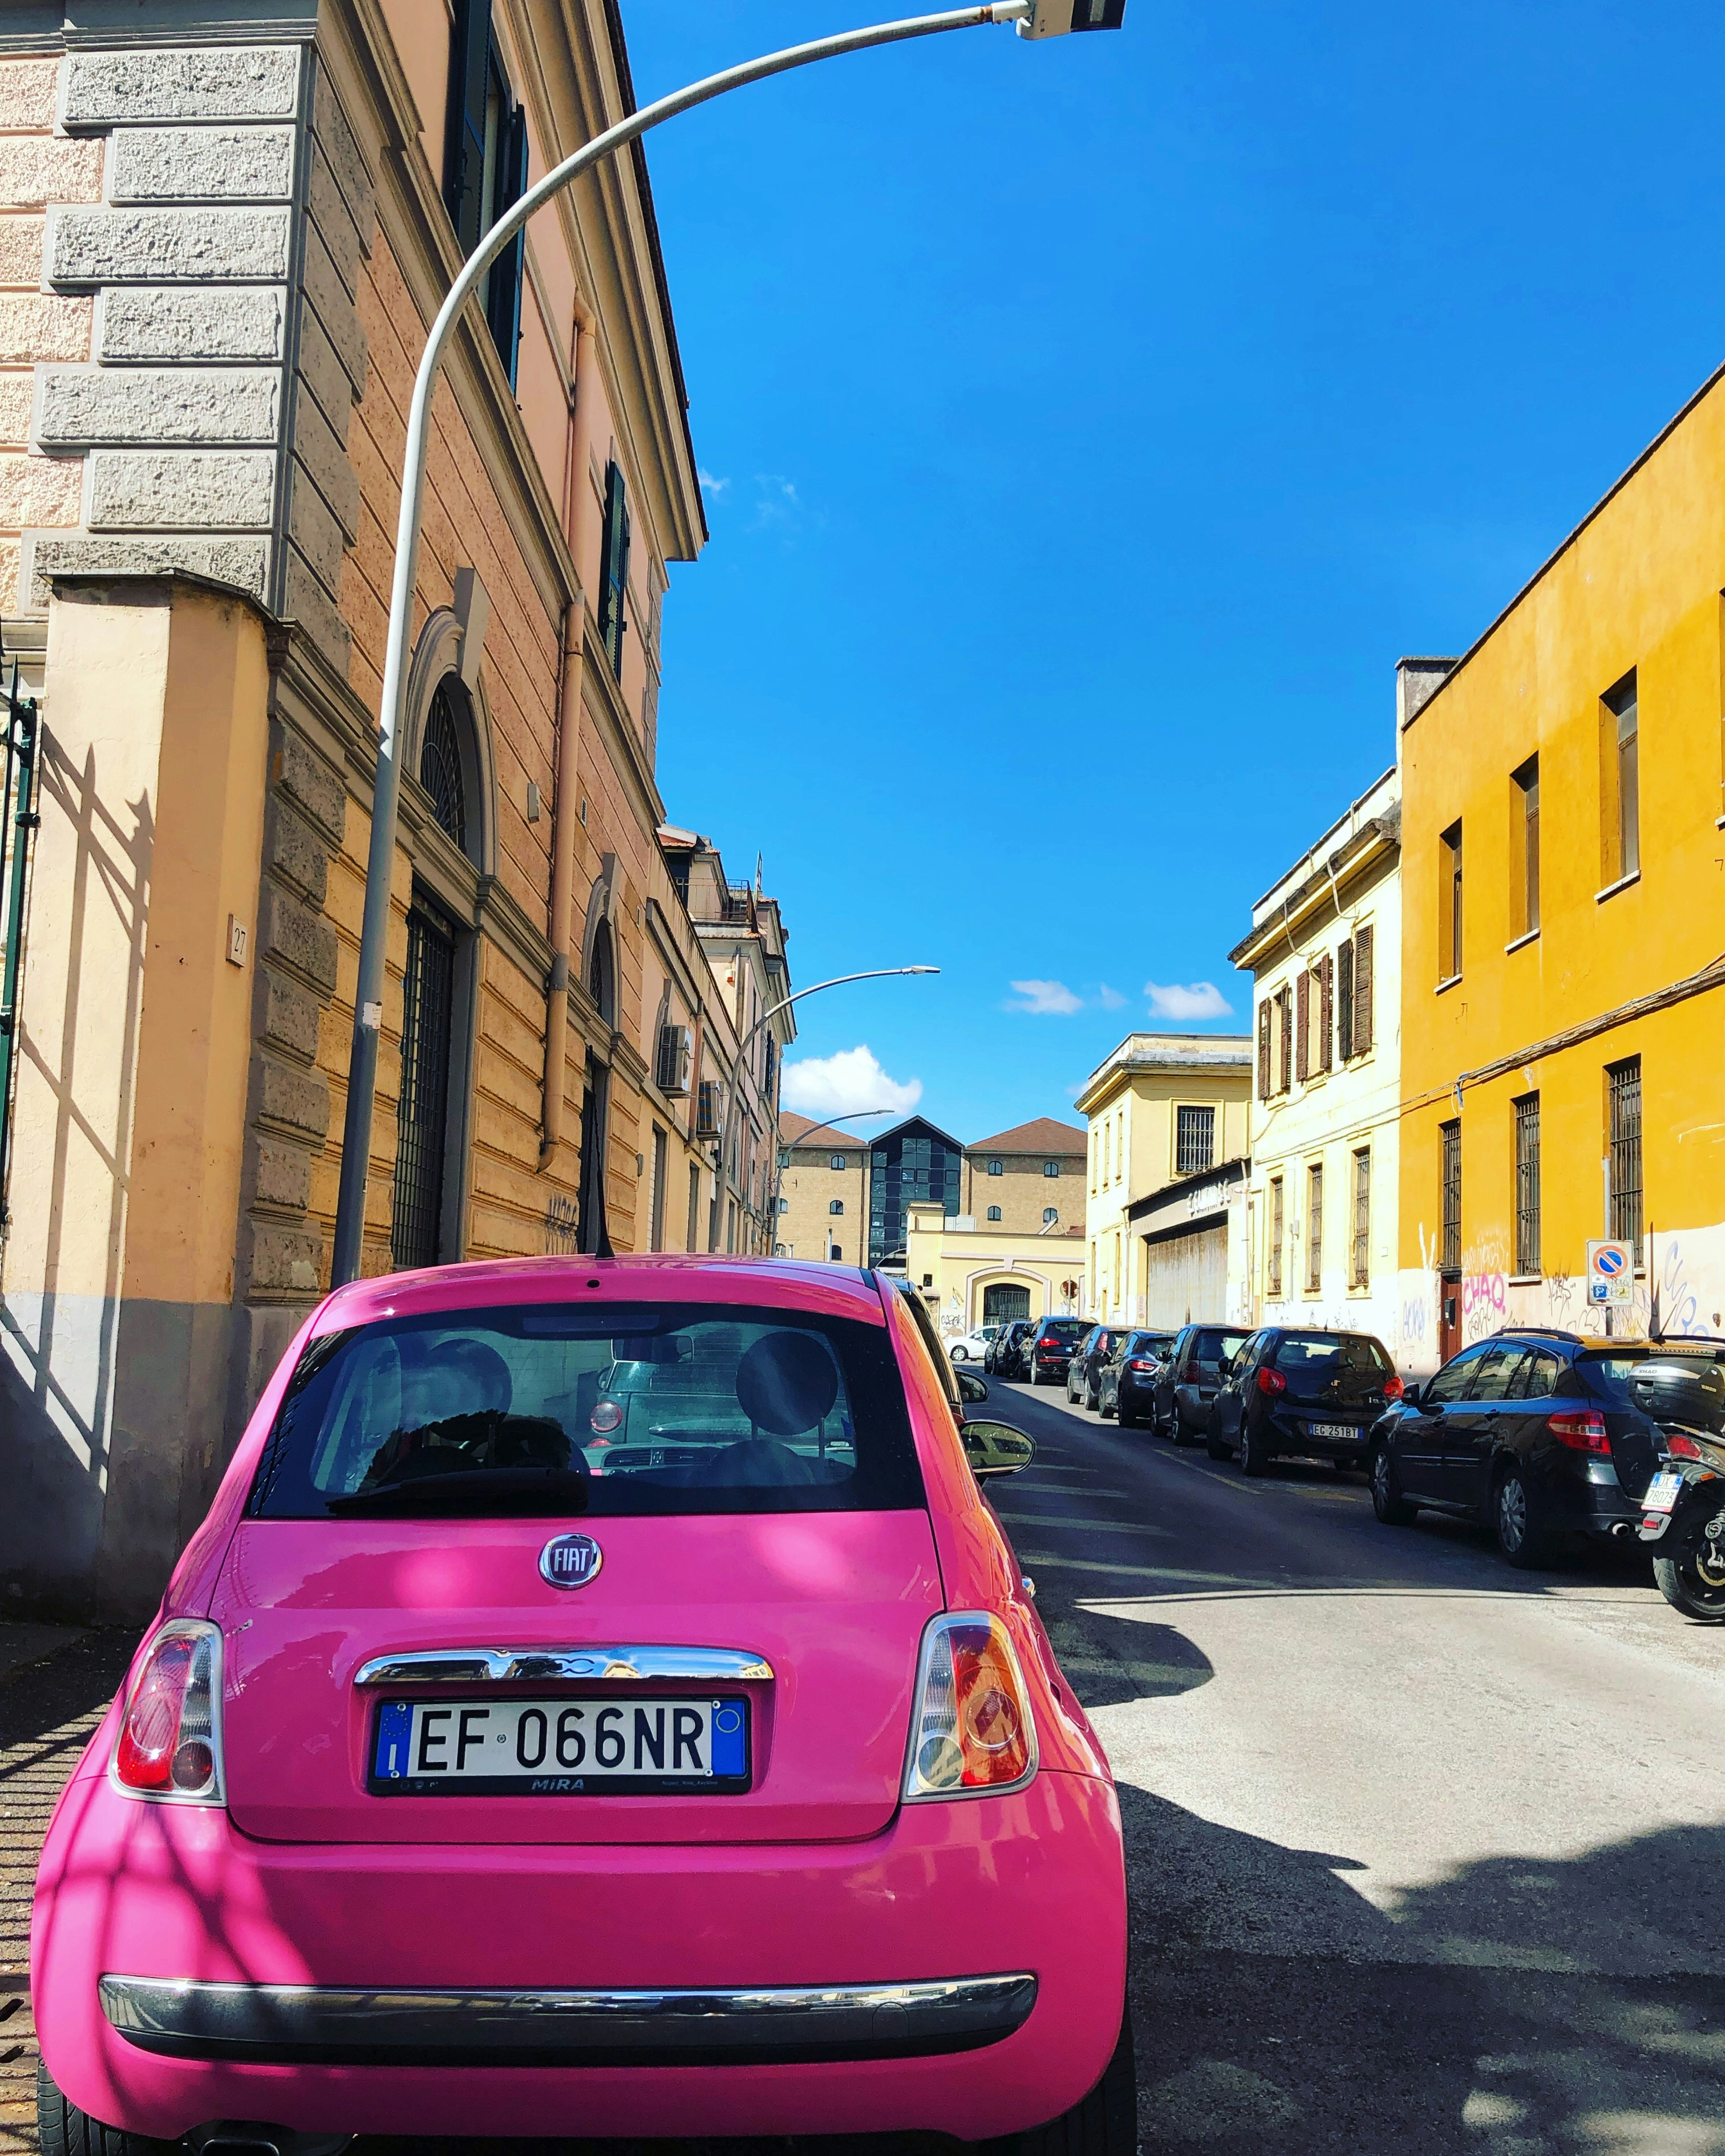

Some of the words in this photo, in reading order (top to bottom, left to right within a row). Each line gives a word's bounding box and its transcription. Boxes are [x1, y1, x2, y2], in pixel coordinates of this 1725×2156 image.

[234, 927, 246, 955] 27
[1314, 1425, 1325, 1434] EG
[1329, 1426, 1357, 1437] 251BT
[1658, 1475, 1671, 1488] DX
[1647, 1490, 1675, 1504] 78073
[554, 1548, 589, 1571] FIAT
[417, 1709, 491, 1771] EF
[516, 1708, 704, 1770] 066NR
